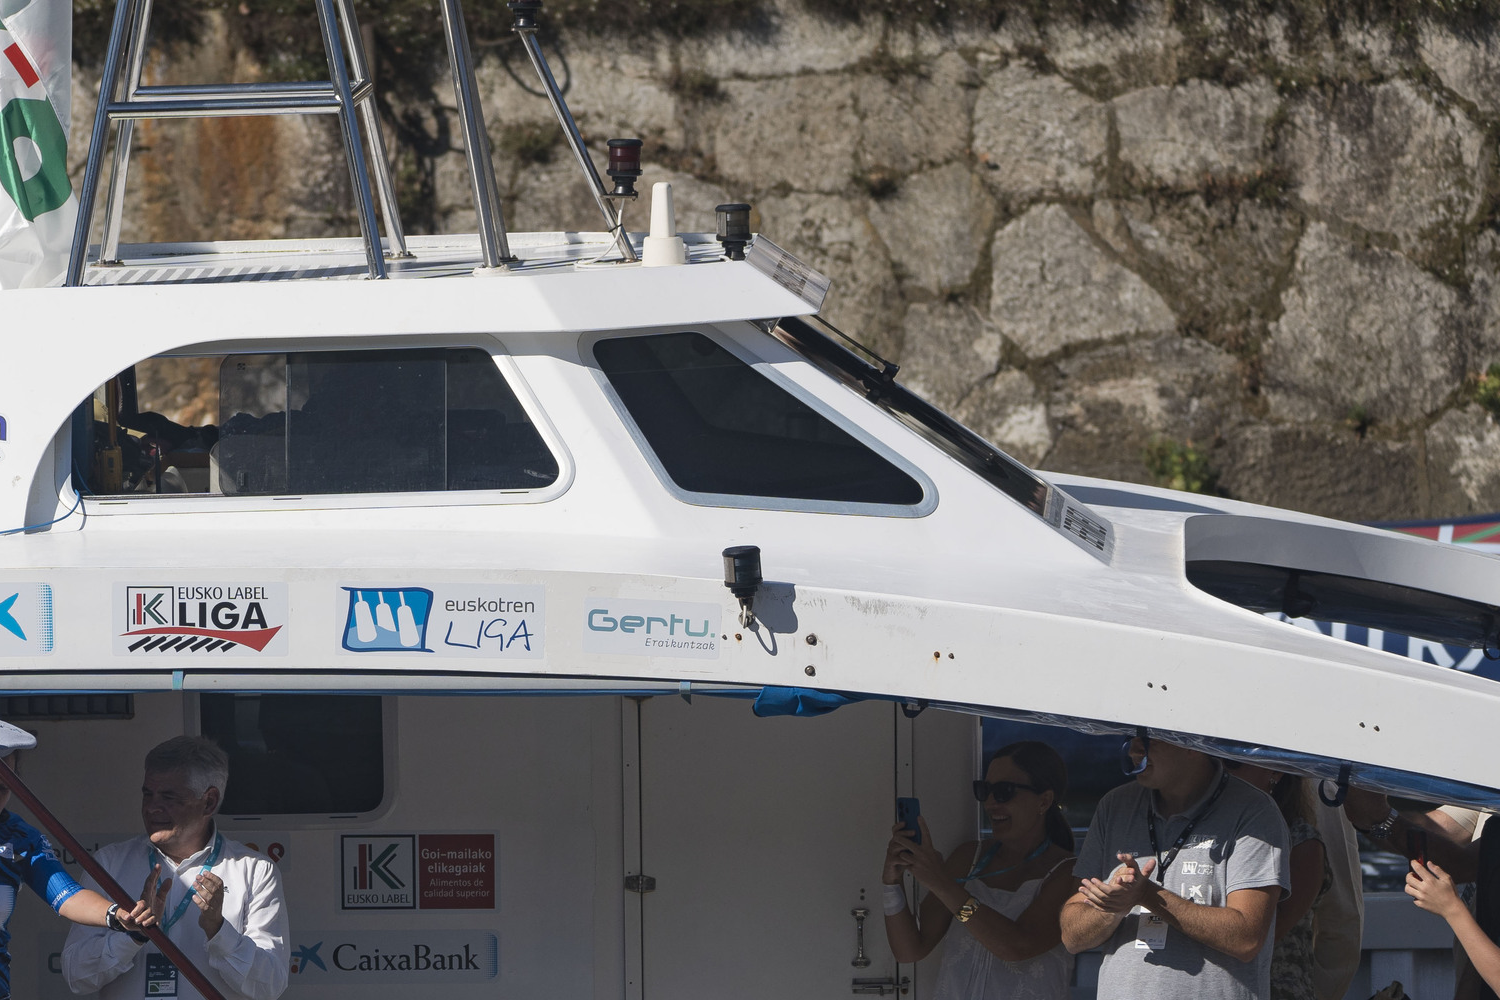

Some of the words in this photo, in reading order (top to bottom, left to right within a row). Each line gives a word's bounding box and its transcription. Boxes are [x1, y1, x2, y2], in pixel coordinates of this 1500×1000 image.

[178, 587, 223, 600] EUSKO
[228, 587, 268, 600] LABEL
[445, 598, 535, 613] euskotren
[179, 602, 268, 629] LIGA
[445, 619, 534, 652] LIGA
[645, 637, 716, 651] Eraikuntzak
[421, 848, 492, 860] Goi-mailako
[427, 862, 486, 876] elikagaiak
[429, 878, 472, 887] Alimentos
[473, 878, 484, 887] de
[348, 894, 379, 904] EUSKO
[382, 894, 411, 904] LABEL
[424, 889, 454, 897] calidad
[456, 890, 490, 899] superior
[333, 943, 480, 972] CaixaBank
